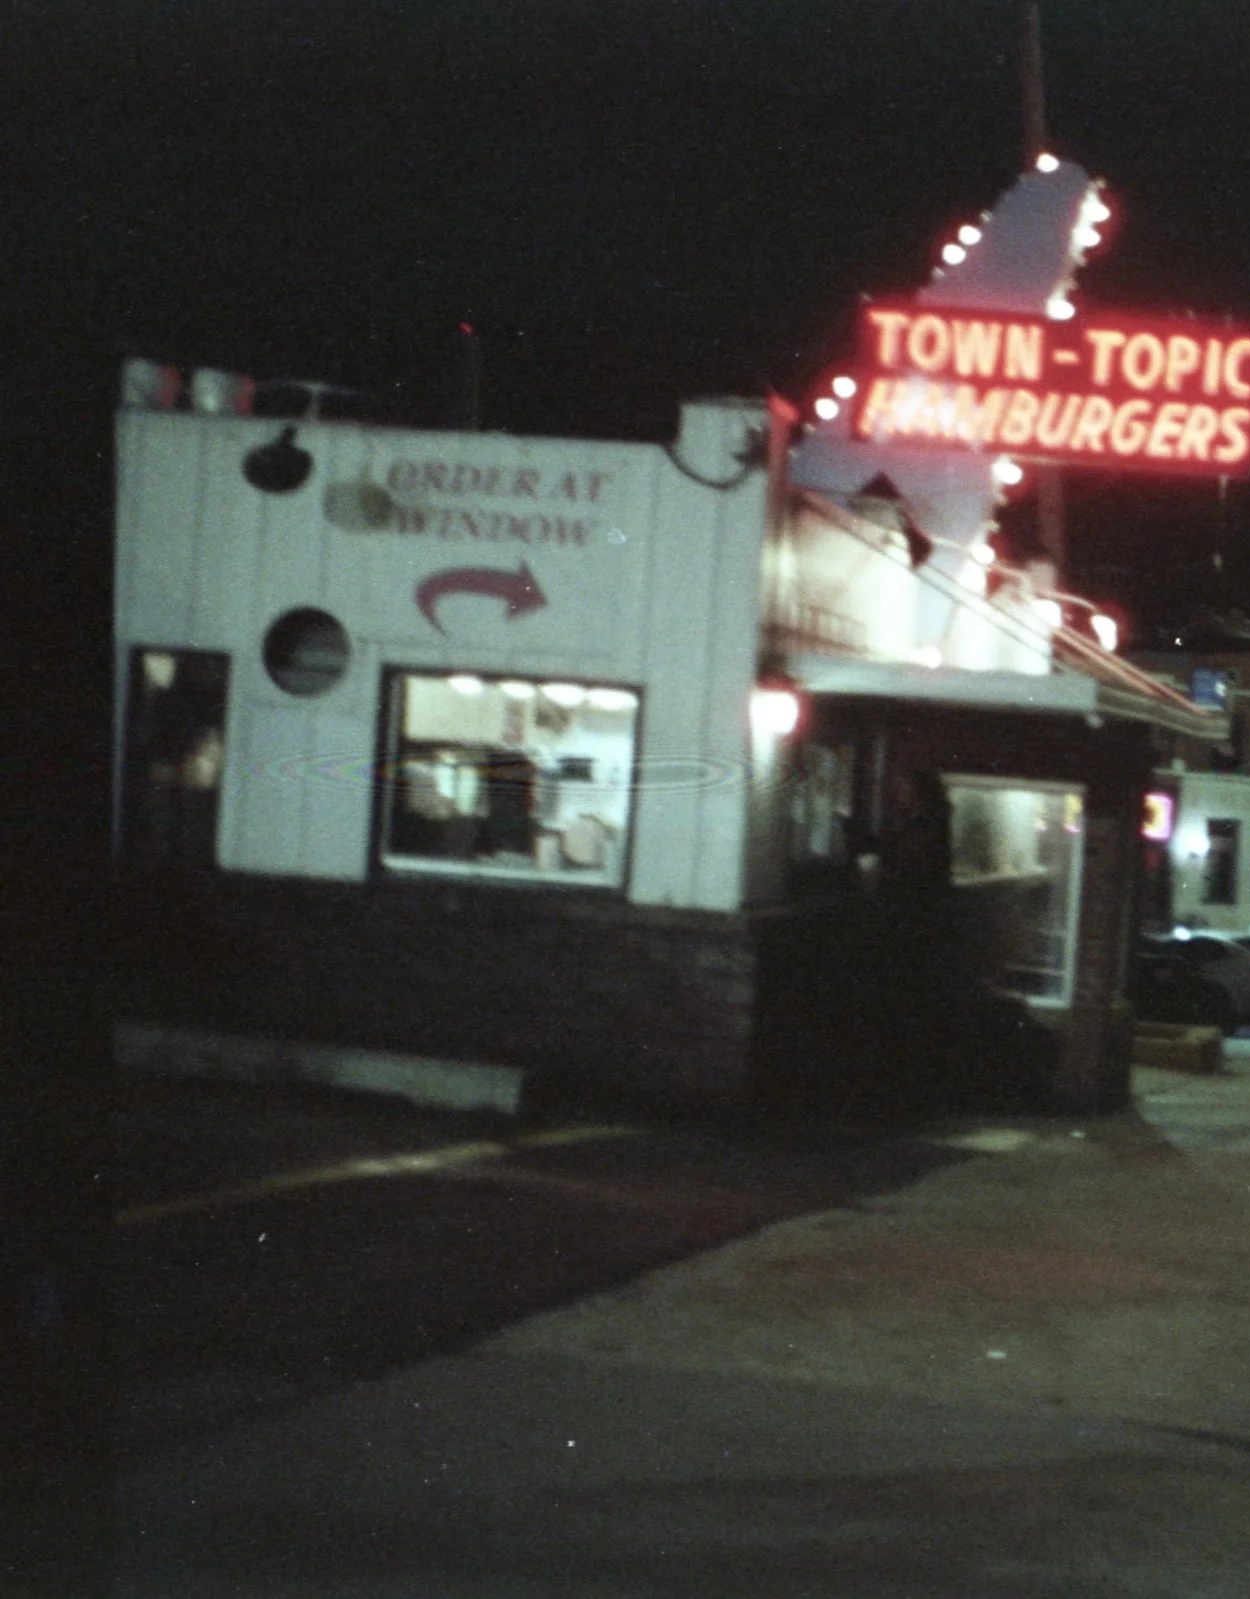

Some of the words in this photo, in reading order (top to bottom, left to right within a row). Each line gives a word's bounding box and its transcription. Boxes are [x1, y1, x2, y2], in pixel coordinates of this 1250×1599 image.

[387, 458, 540, 501] ORDER
[553, 469, 611, 503] AT
[390, 505, 600, 548] WINDOW
